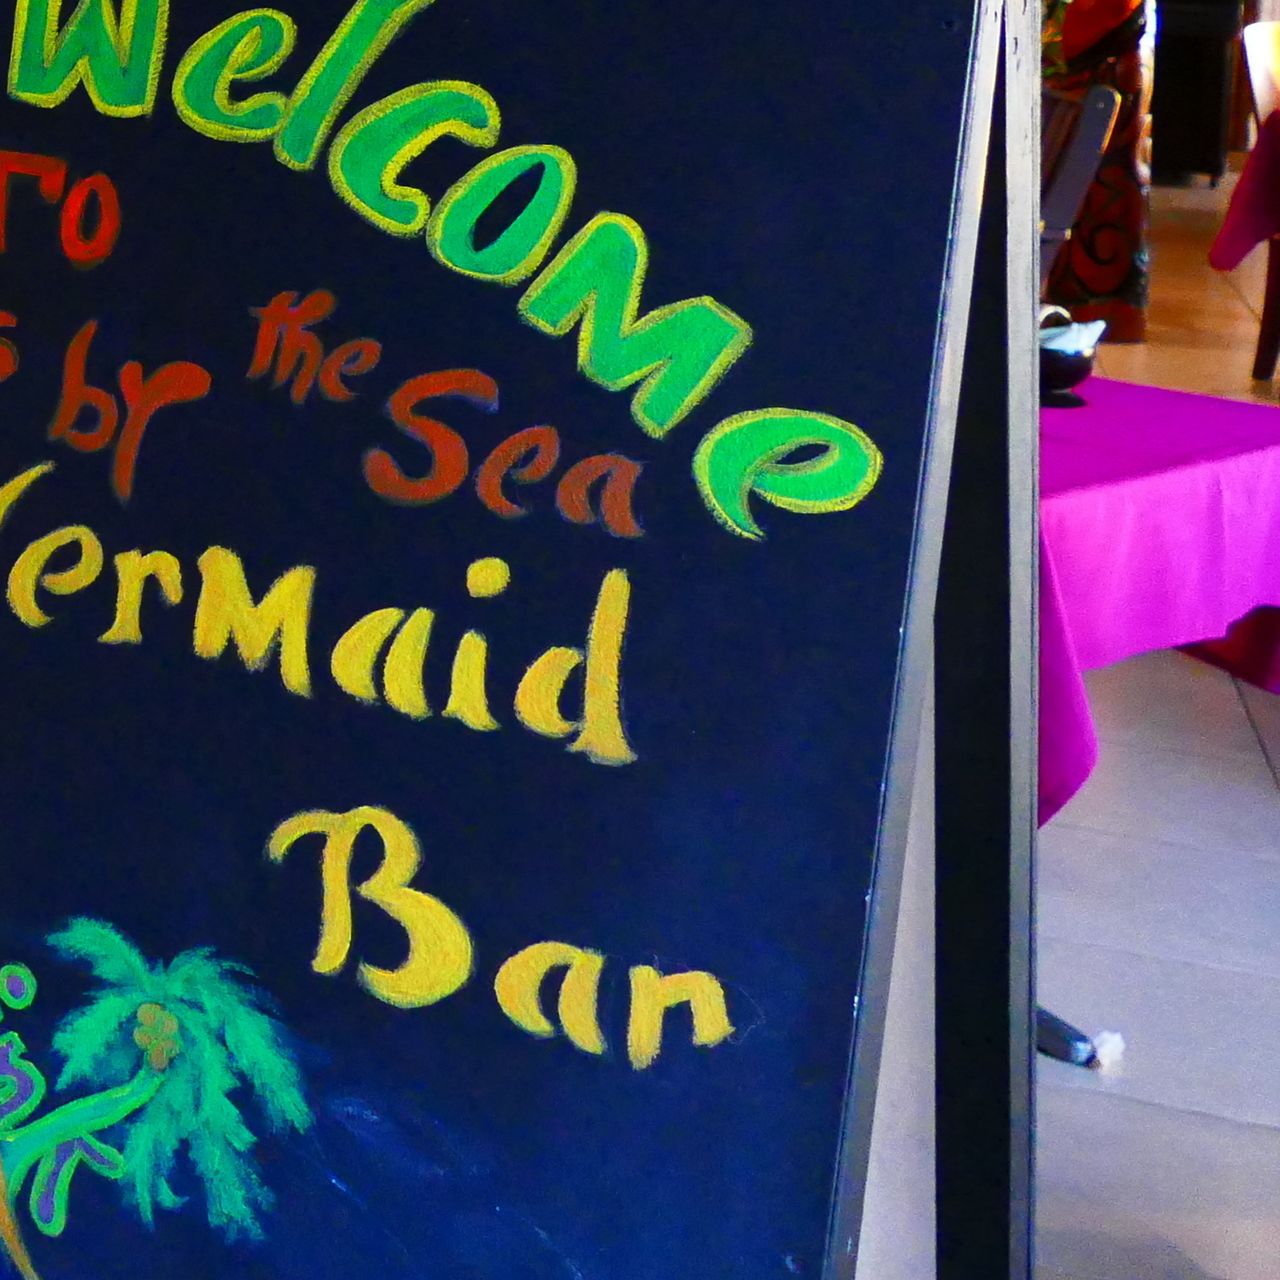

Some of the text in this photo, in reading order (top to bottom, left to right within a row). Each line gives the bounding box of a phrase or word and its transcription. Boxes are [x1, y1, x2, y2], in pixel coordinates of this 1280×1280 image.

[48, 320, 211, 502] by
[248, 289, 382, 404] the
[362, 367, 644, 538] Sea
